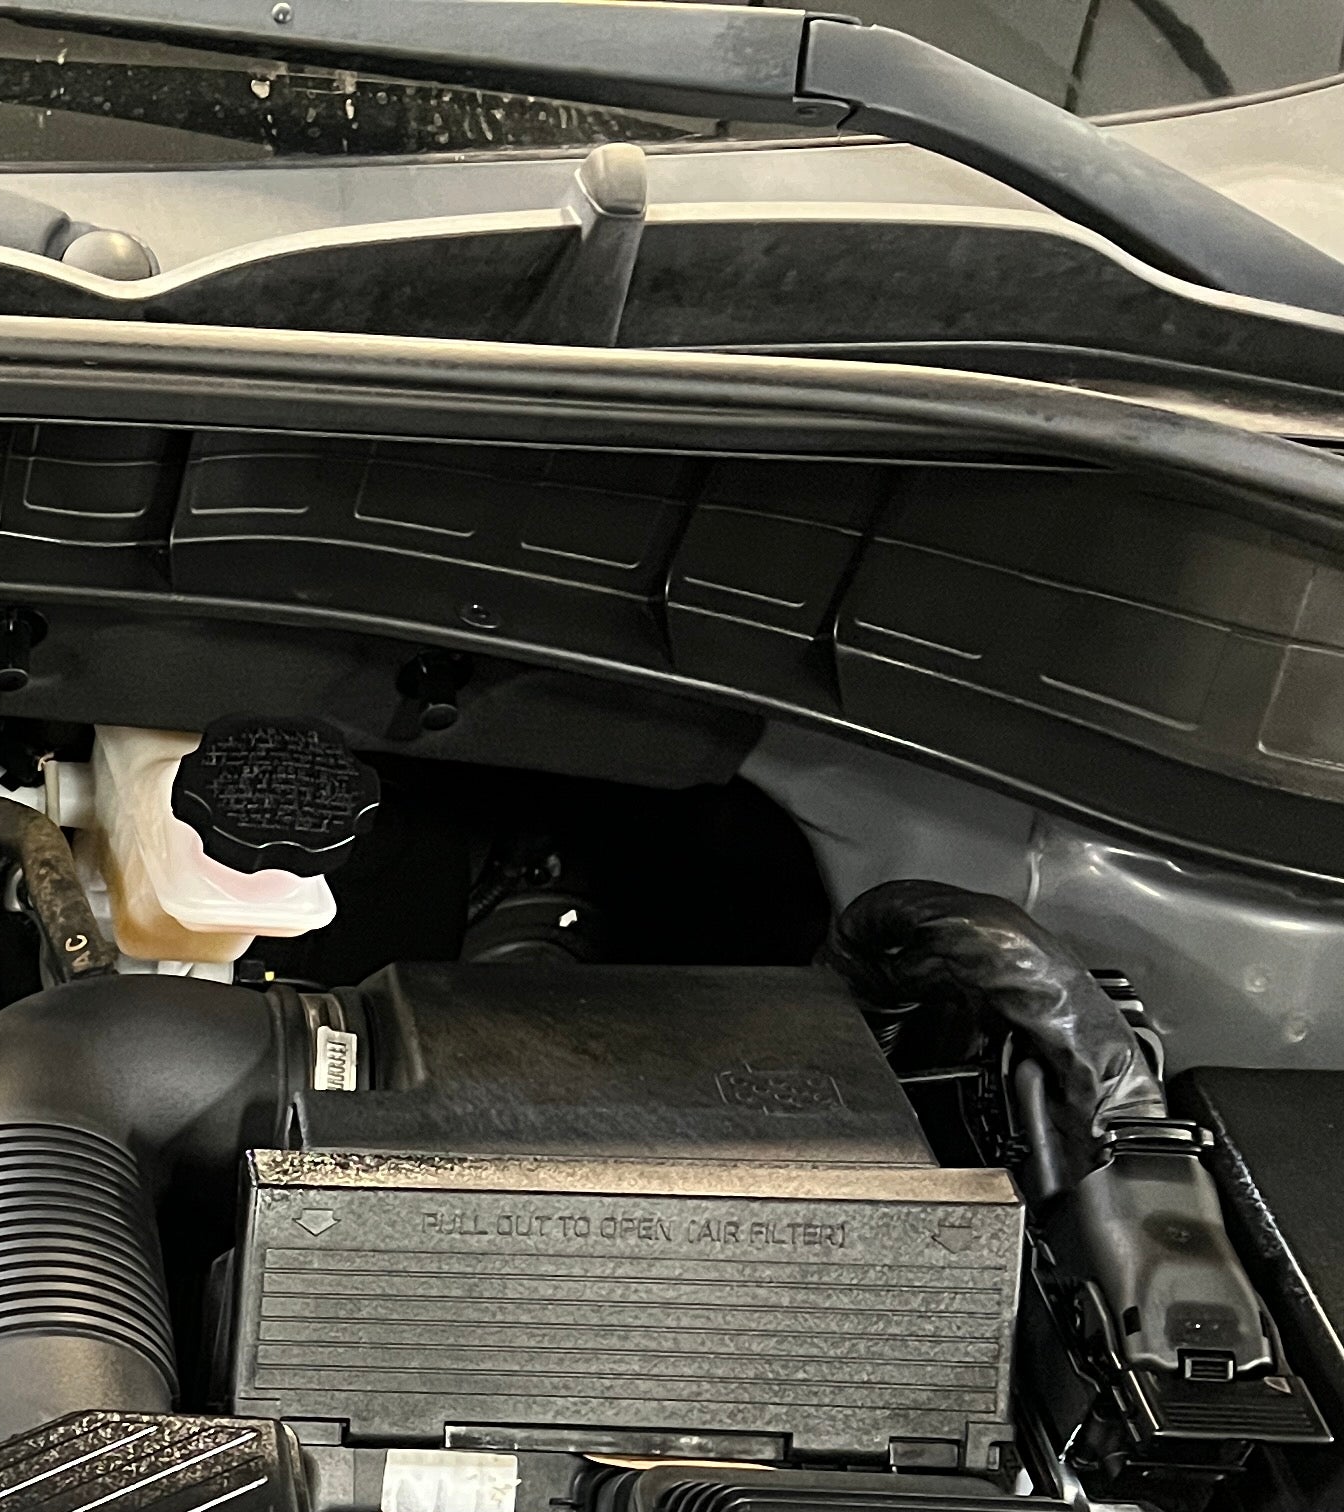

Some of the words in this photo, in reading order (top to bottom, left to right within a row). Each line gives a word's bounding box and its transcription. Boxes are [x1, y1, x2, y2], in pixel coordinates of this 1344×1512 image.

[421, 1212, 489, 1236] PULL
[496, 1214, 553, 1237] OUT
[558, 1215, 591, 1238] TO
[600, 1216, 673, 1242] OPEN
